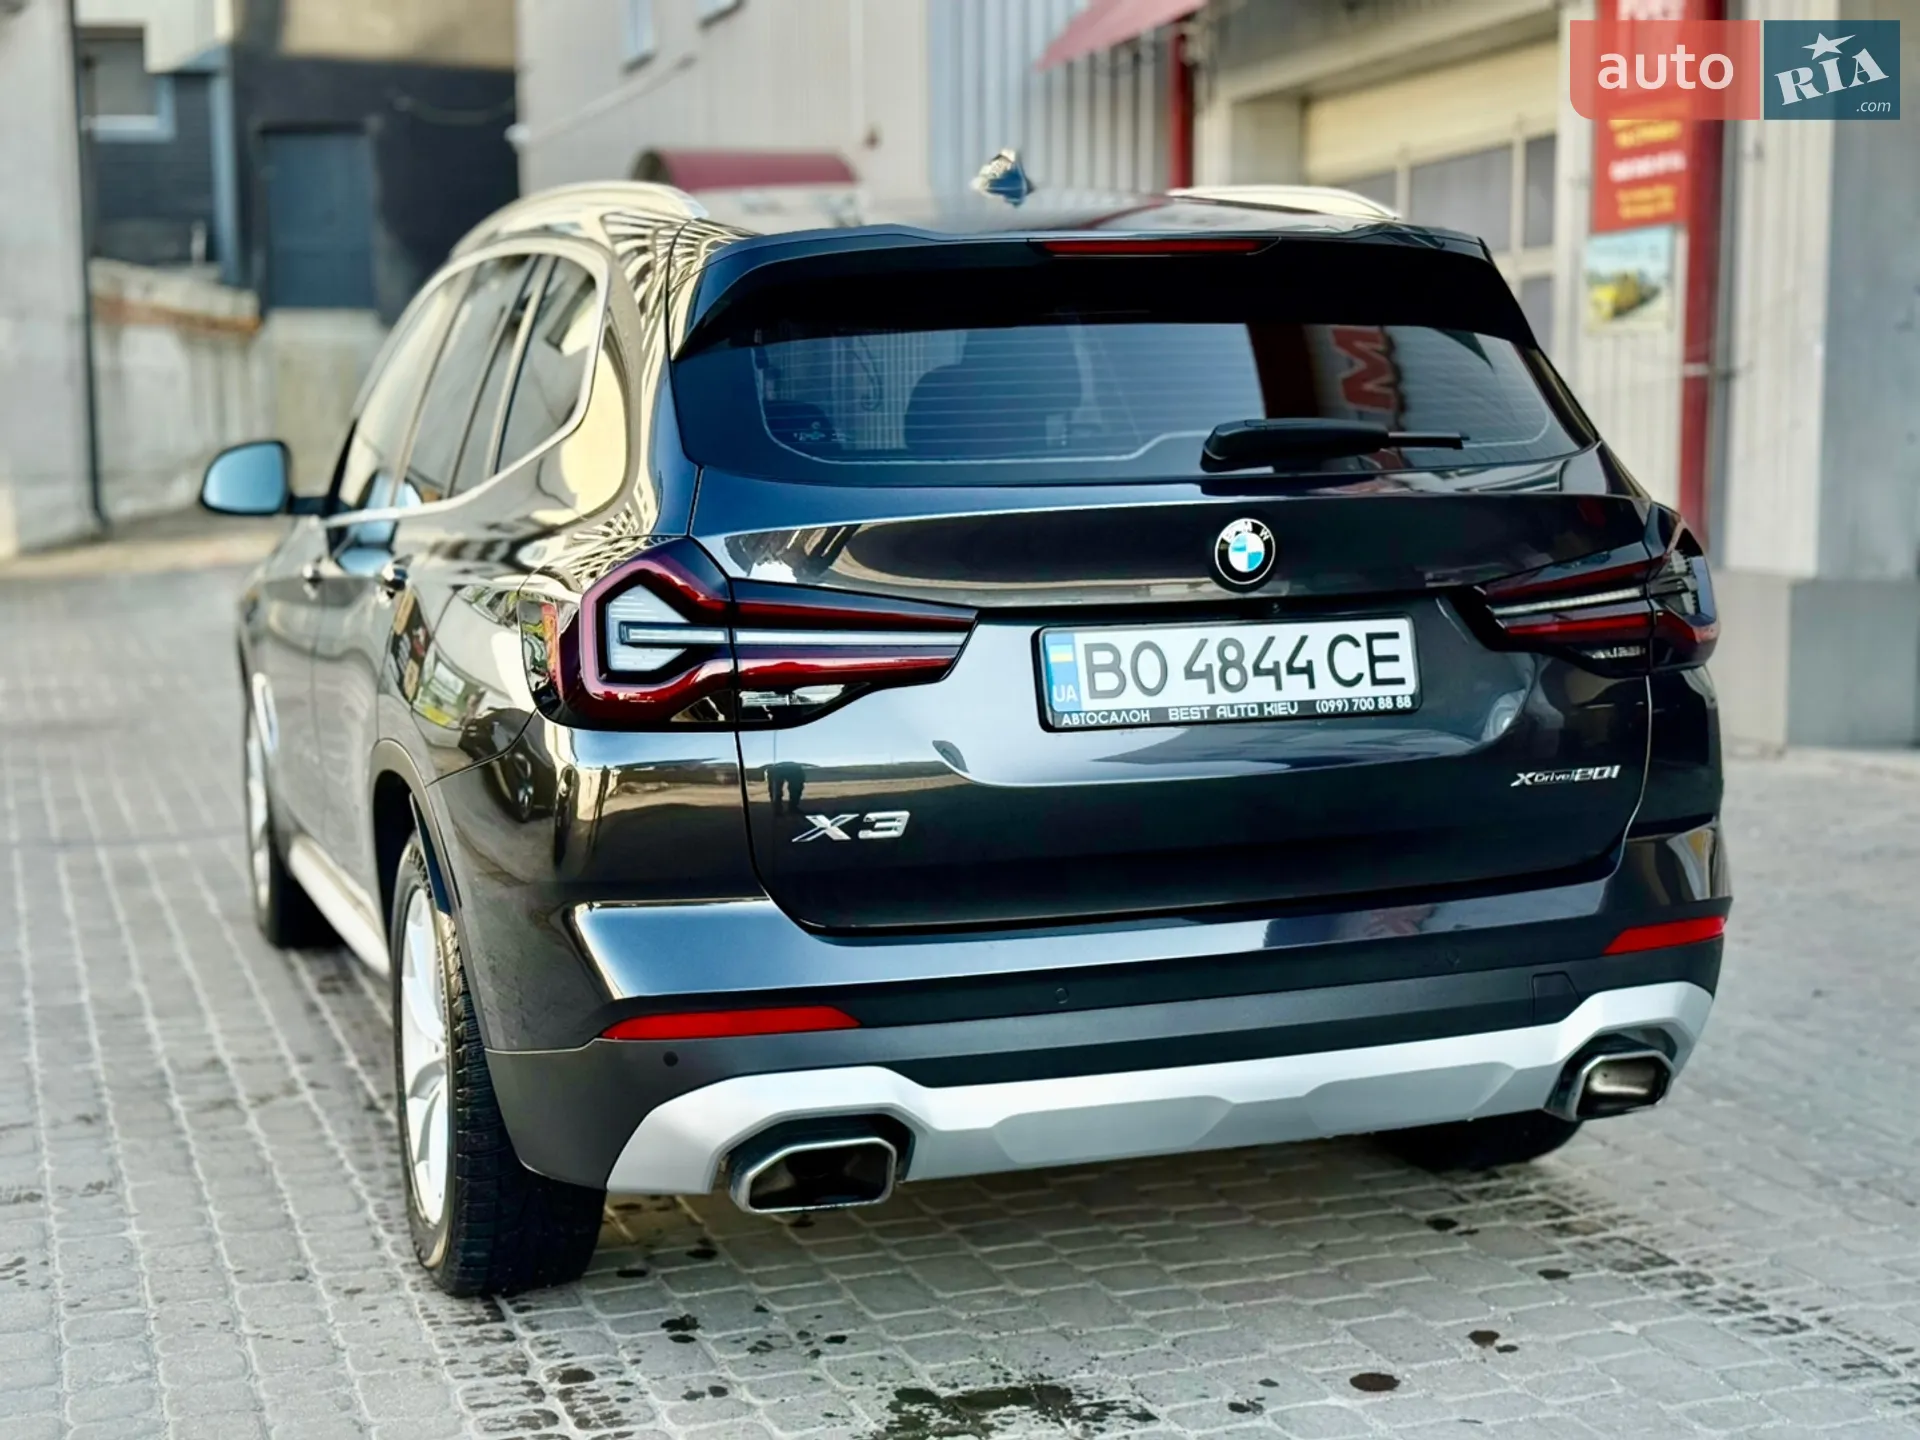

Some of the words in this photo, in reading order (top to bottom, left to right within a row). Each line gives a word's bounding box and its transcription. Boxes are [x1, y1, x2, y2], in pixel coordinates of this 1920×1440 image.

[1084, 640, 1168, 699] BO
[1184, 635, 1316, 695] 4844
[1327, 631, 1406, 688] CE
[1052, 684, 1079, 702] UA
[1061, 709, 1151, 726] АВТОСАЛОН
[1168, 706, 1211, 720] BEST
[1216, 703, 1258, 719] AUTO
[1263, 701, 1298, 716] KIEV
[1315, 698, 1349, 713] (099)
[1352, 697, 1375, 711] 700
[1378, 696, 1394, 710] 88
[1396, 695, 1412, 708] 88
[791, 810, 911, 842] X3
